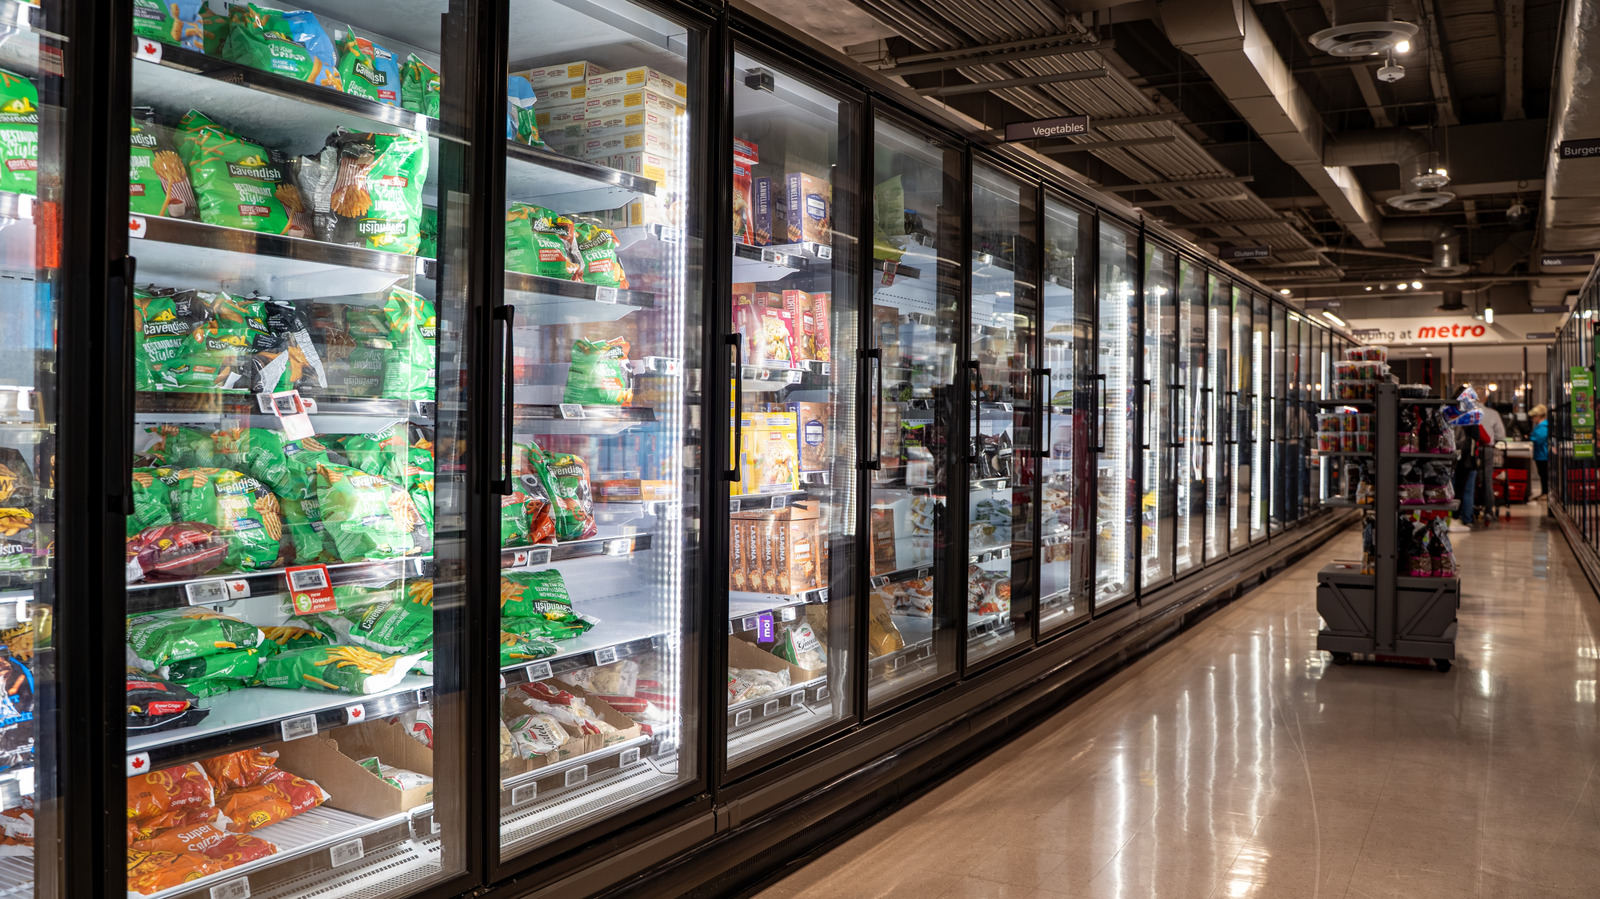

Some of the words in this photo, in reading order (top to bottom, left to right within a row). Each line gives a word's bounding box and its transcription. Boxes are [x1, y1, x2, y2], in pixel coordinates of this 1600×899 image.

[1033, 123, 1084, 137] Vegetables
[7, 140, 37, 159] Style
[230, 165, 281, 179] Cavendish
[233, 183, 272, 197] RESTAURANT
[790, 177, 798, 210] CANNELLONI
[240, 190, 265, 205] Style
[760, 181, 768, 215] CANNELLONI
[359, 222, 406, 234] Cavendish
[586, 249, 613, 261] CRISP
[815, 298, 825, 330] TORTELLINI
[143, 320, 190, 335] Cavendish
[1399, 330, 1412, 339] at
[1418, 323, 1486, 338] metro
[142, 339, 182, 353] RESTAURANT
[149, 349, 176, 363] Style
[354, 361, 382, 371] RESTAURANT
[343, 377, 379, 386] Cavendish
[535, 601, 573, 613] Cavendish
[762, 619, 771, 638] moi
[177, 824, 212, 843] Super
